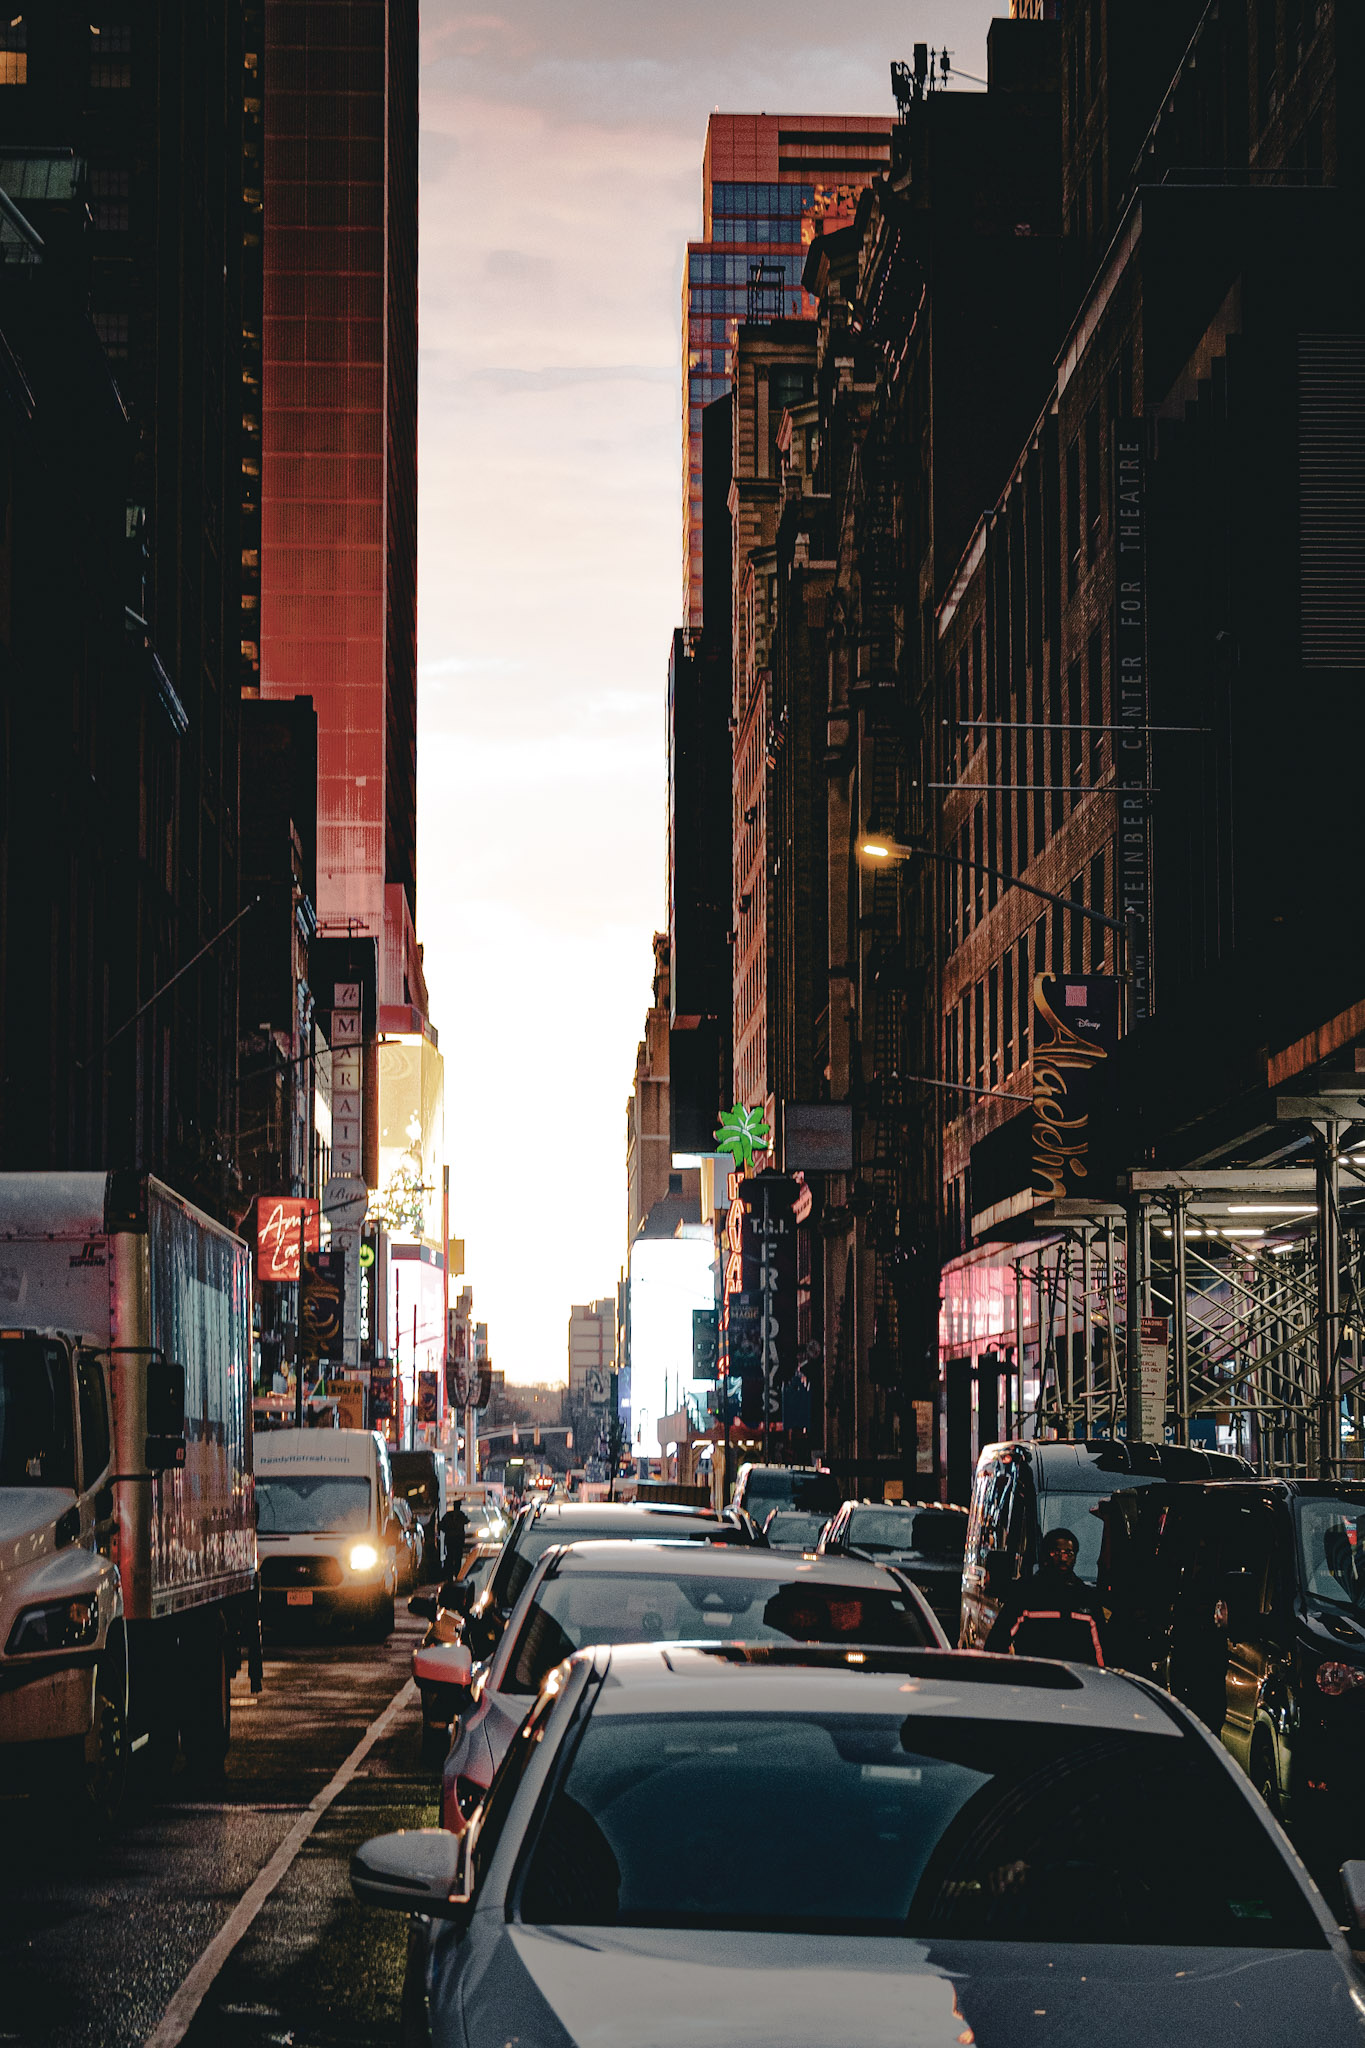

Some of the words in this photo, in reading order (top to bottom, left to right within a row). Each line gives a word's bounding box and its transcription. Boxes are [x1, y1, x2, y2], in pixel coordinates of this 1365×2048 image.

[1119, 442, 1141, 553] THEATRE
[1120, 580, 1141, 626] FOR
[1075, 1017, 1101, 1031] Disney
[338, 1018, 356, 1167] MARAIS
[1032, 972, 1108, 1198] Aladdin
